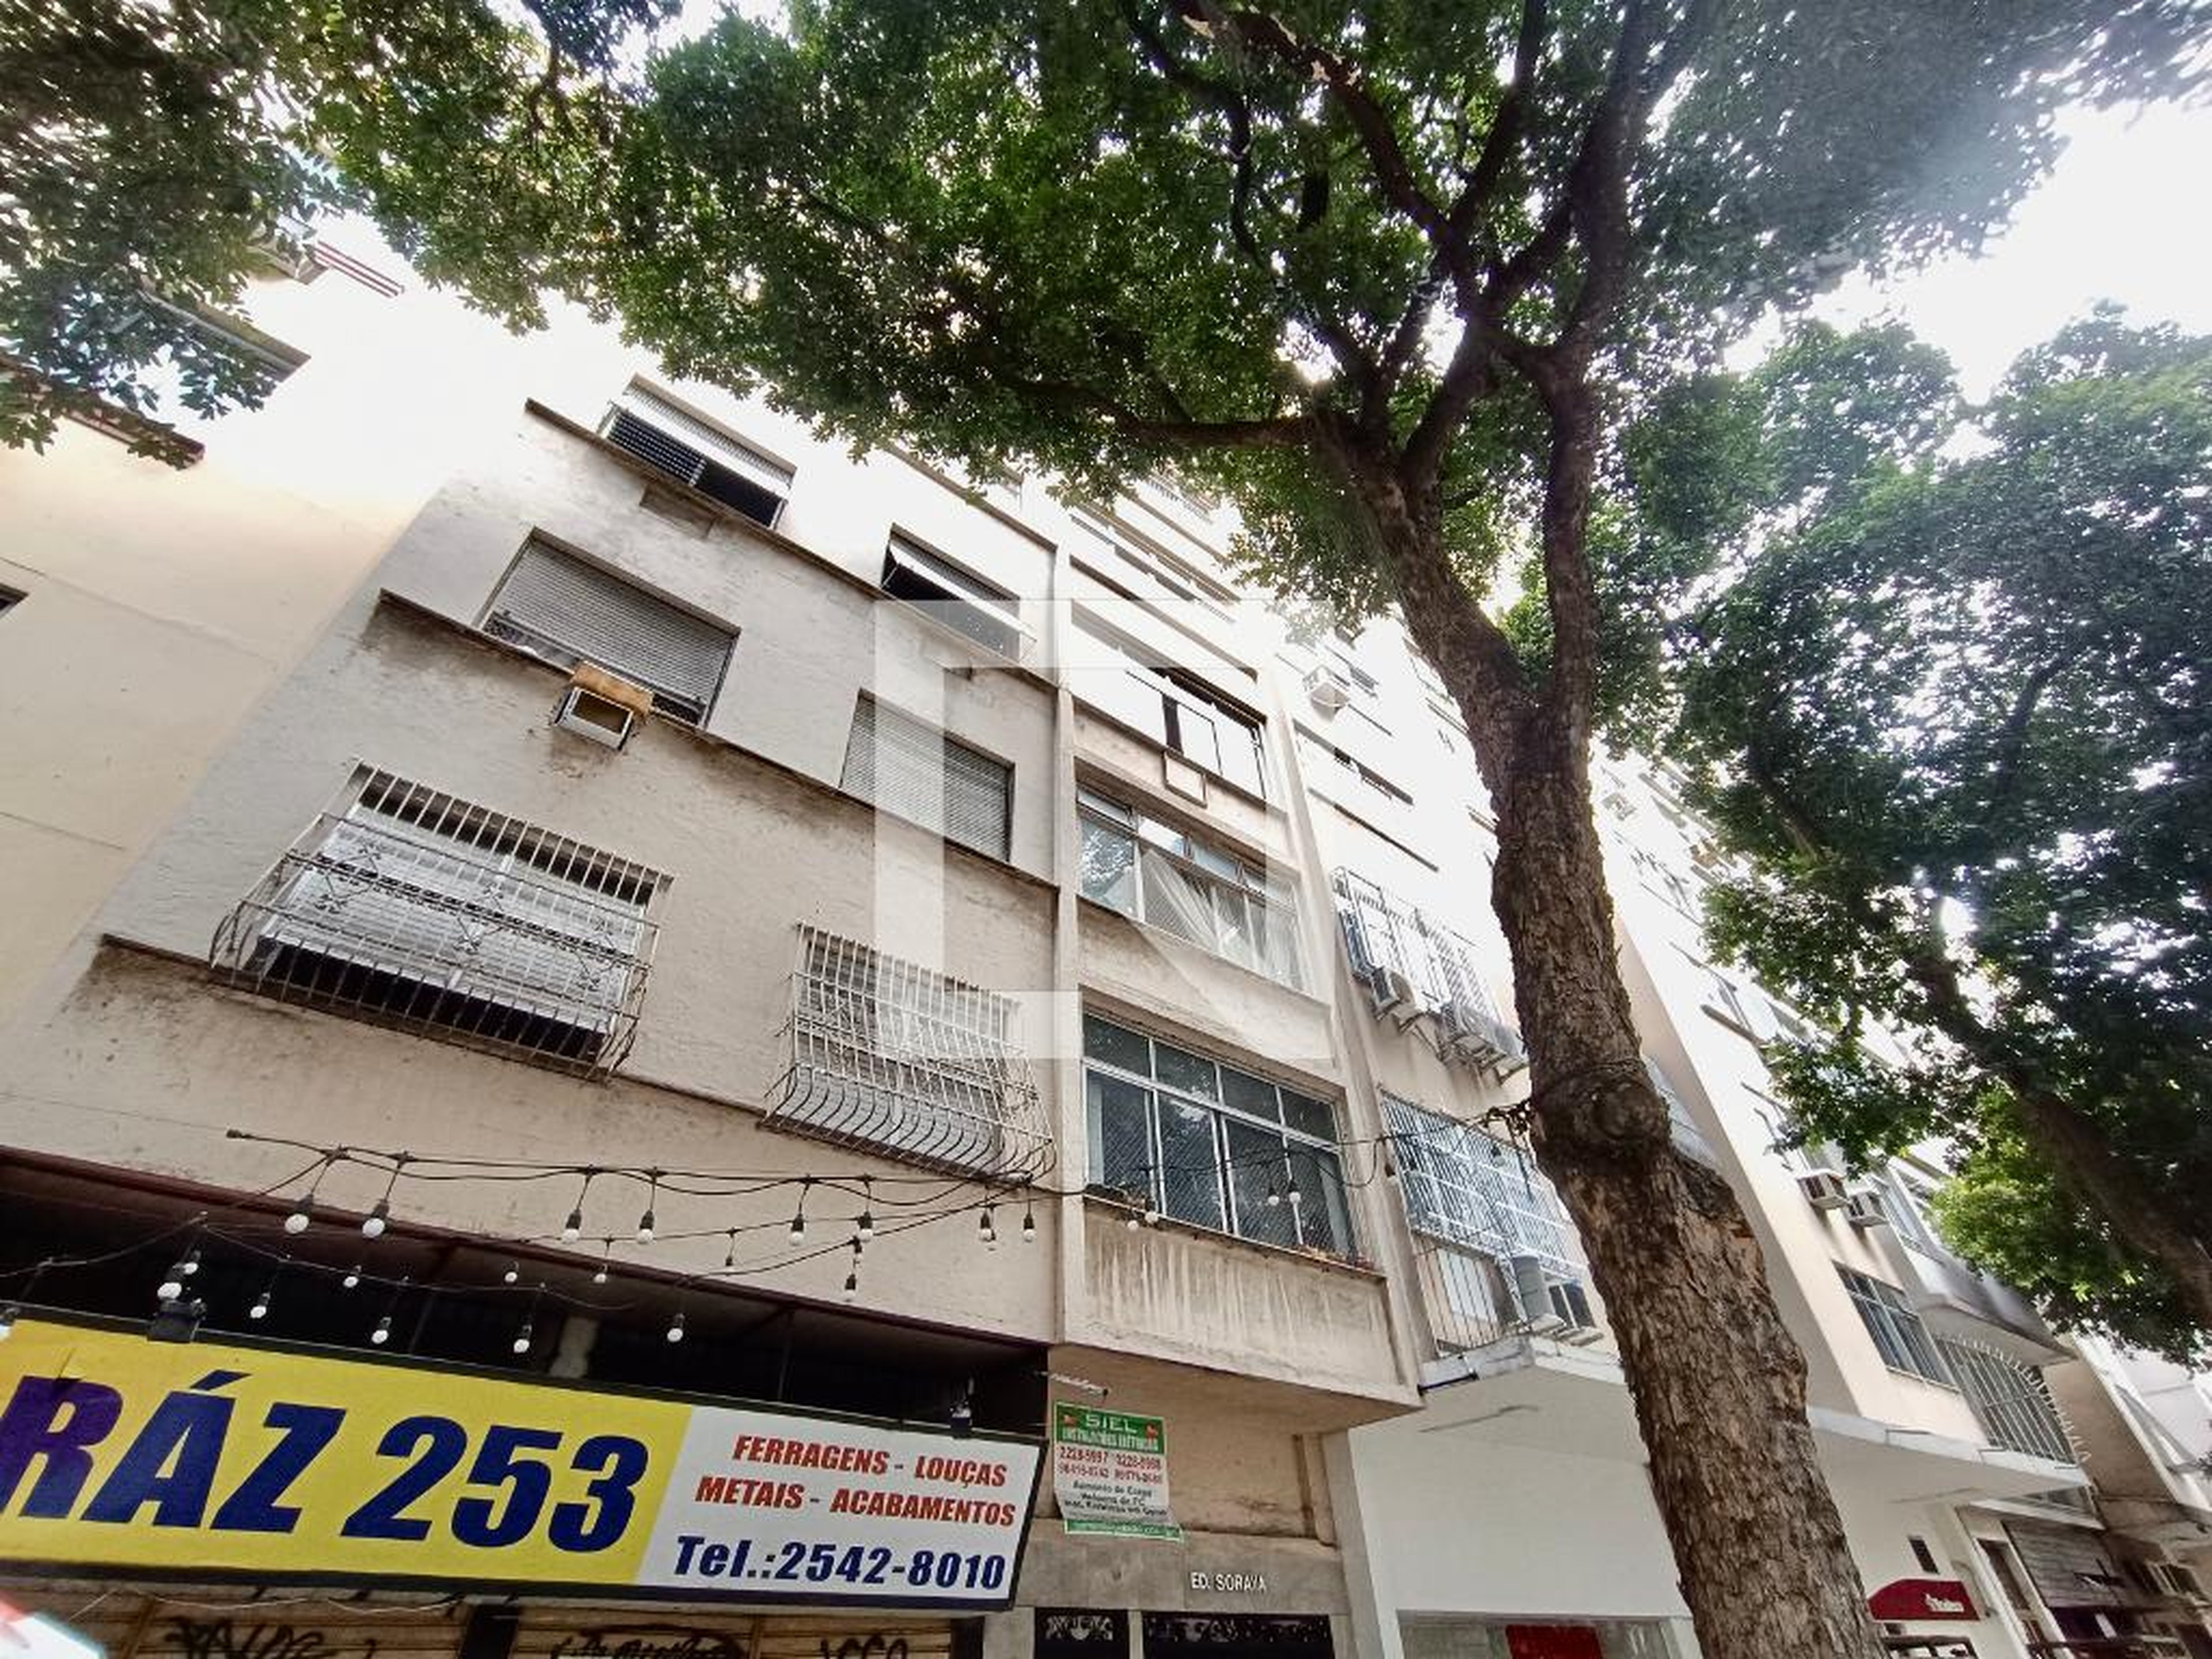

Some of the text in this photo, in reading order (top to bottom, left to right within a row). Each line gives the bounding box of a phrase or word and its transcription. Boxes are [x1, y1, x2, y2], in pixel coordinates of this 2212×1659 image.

[1085, 1414, 1137, 1434] SIEL
[340, 1415, 649, 1553] 253
[732, 1434, 889, 1476] FERRAGENS
[914, 1455, 1007, 1489] LOUÇAS
[694, 1476, 805, 1510] METAIS
[829, 1487, 1016, 1528] ACABAMENTOS
[673, 1535, 1006, 1590] Tel.:2542-8010
[1191, 1571, 1267, 1593] ED. SORAYA
